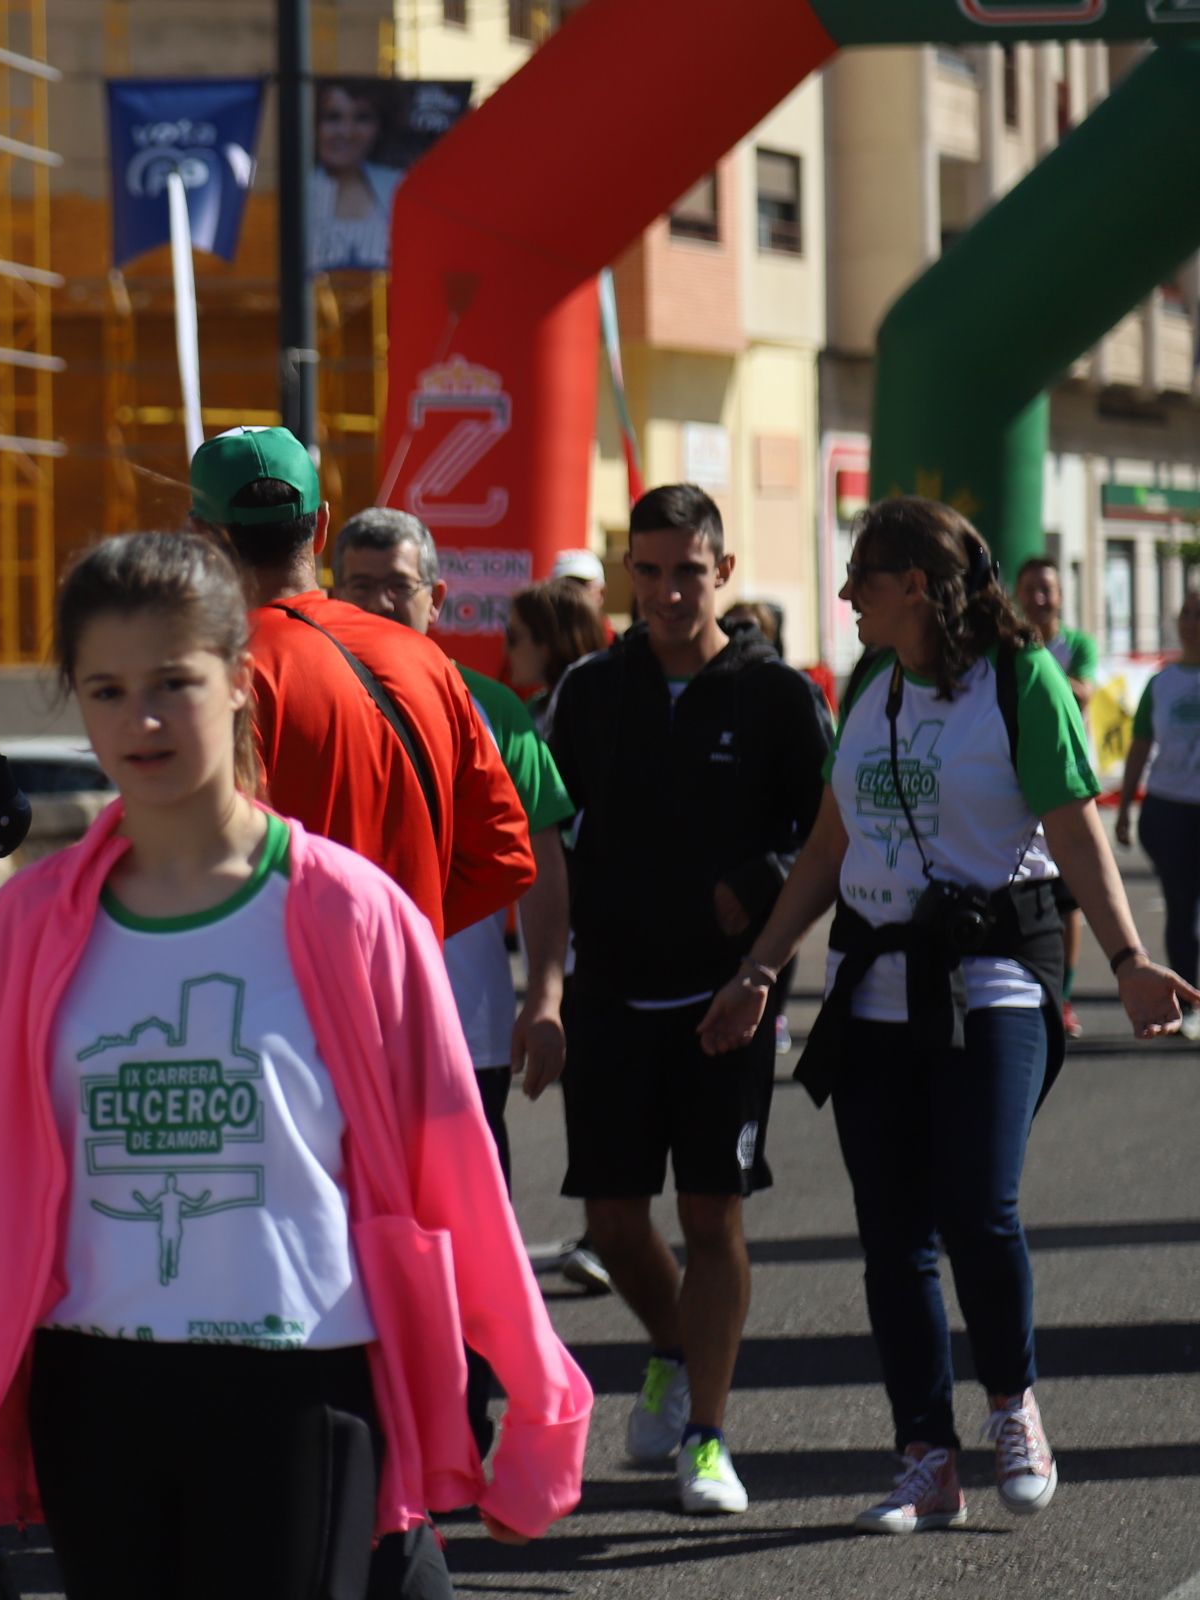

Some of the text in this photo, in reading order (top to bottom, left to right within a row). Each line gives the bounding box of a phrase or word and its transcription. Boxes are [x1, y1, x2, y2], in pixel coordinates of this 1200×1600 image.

[124, 1065, 219, 1086] IX CARRERA
[96, 1086, 251, 1125] EL CERCO
[132, 1129, 218, 1150] DE ZAMORA
